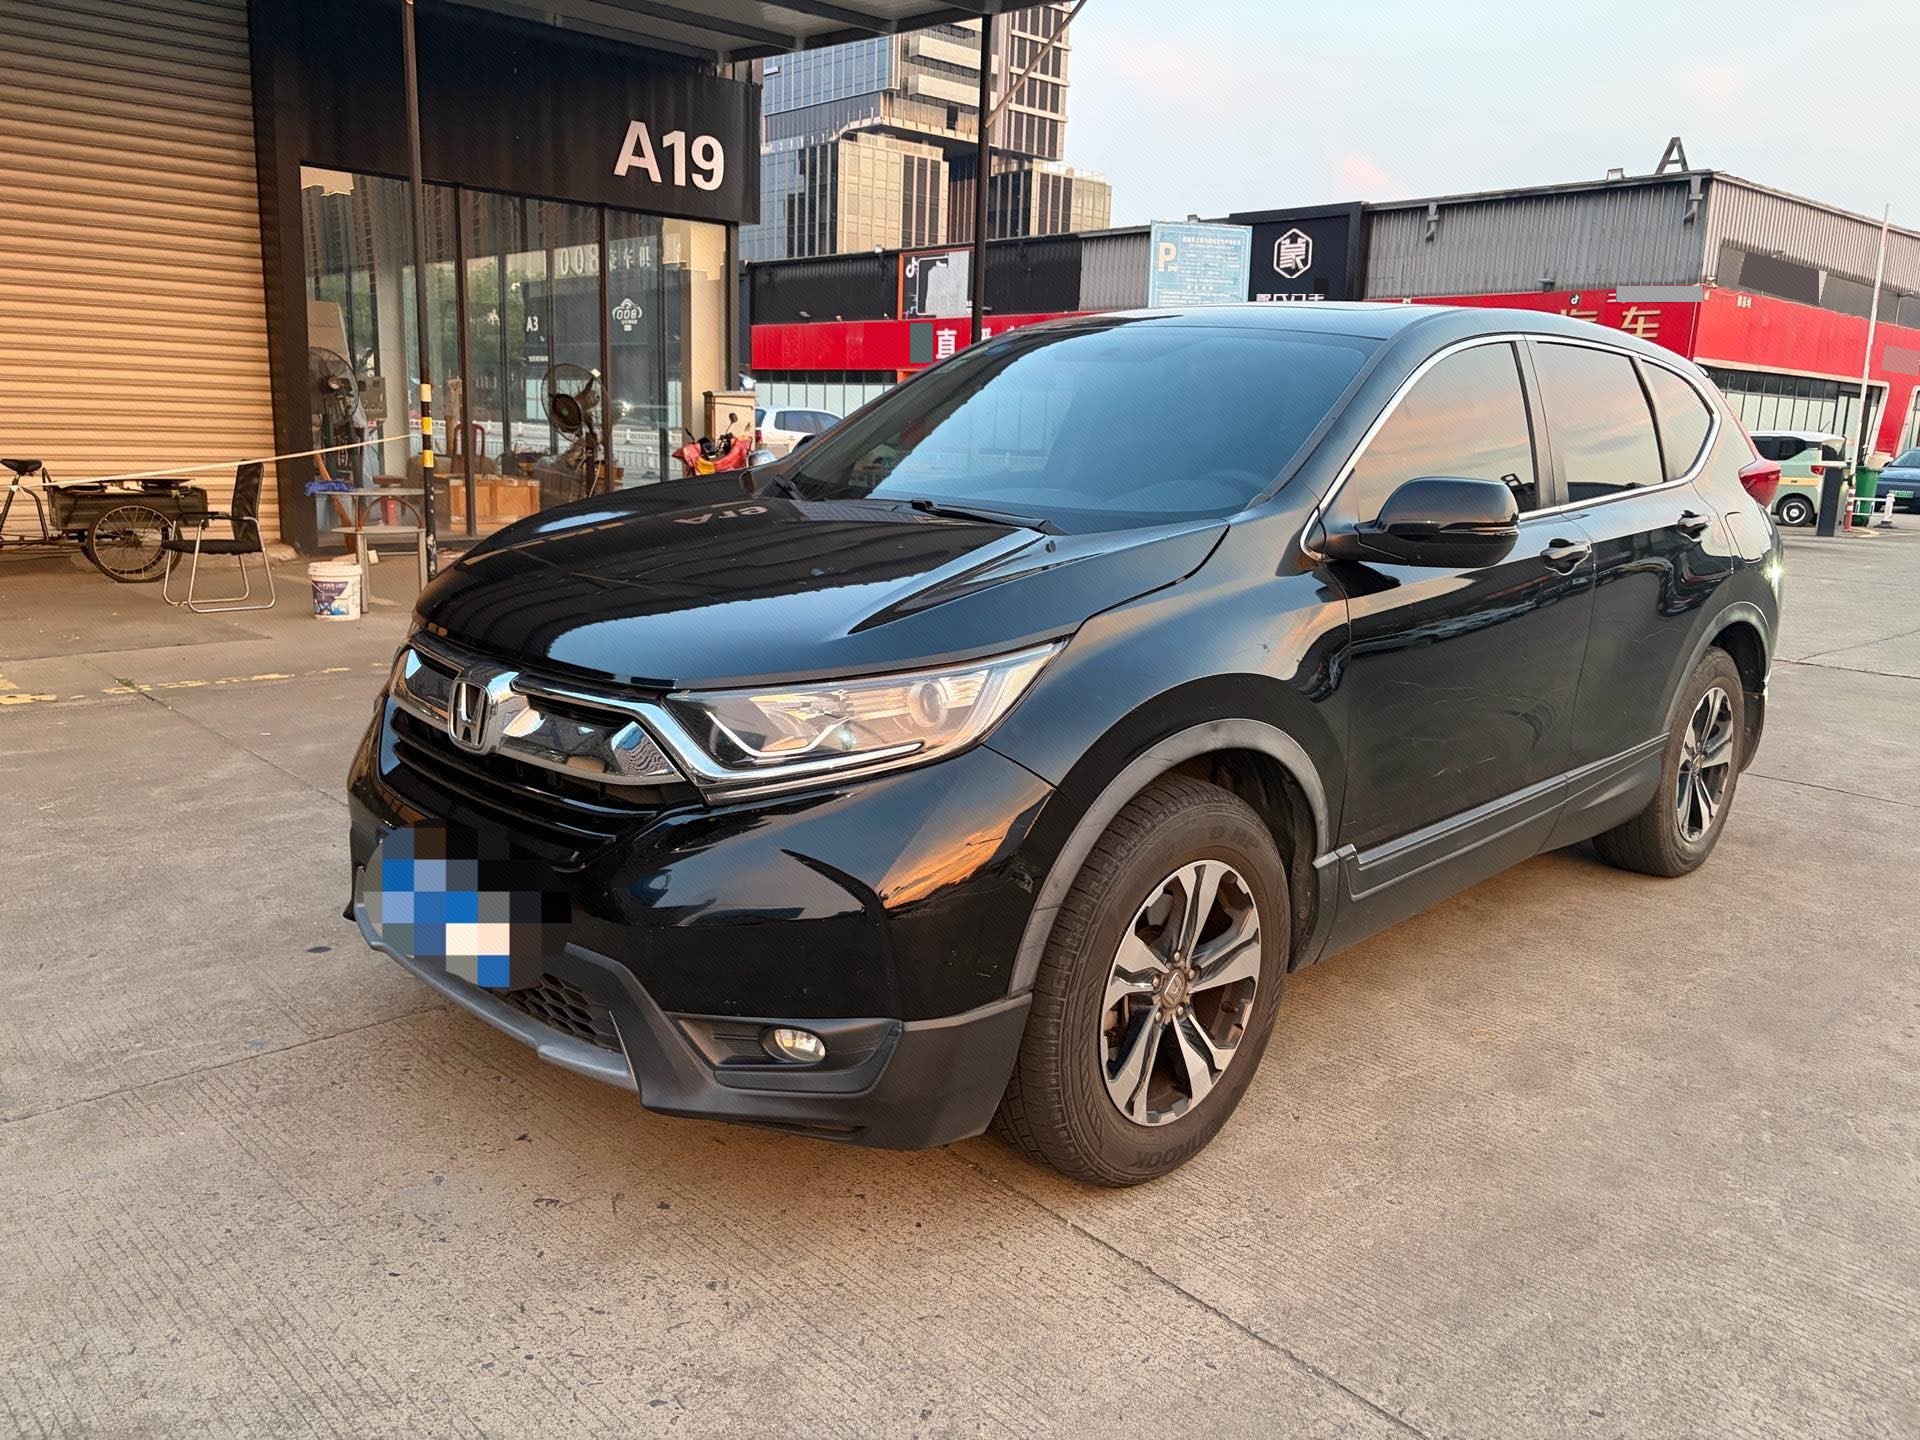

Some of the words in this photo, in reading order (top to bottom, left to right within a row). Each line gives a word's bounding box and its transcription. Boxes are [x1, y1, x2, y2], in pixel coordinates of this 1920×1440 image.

[613, 119, 726, 191] A19
[1655, 137, 1689, 174] A
[1158, 242, 1177, 273] P
